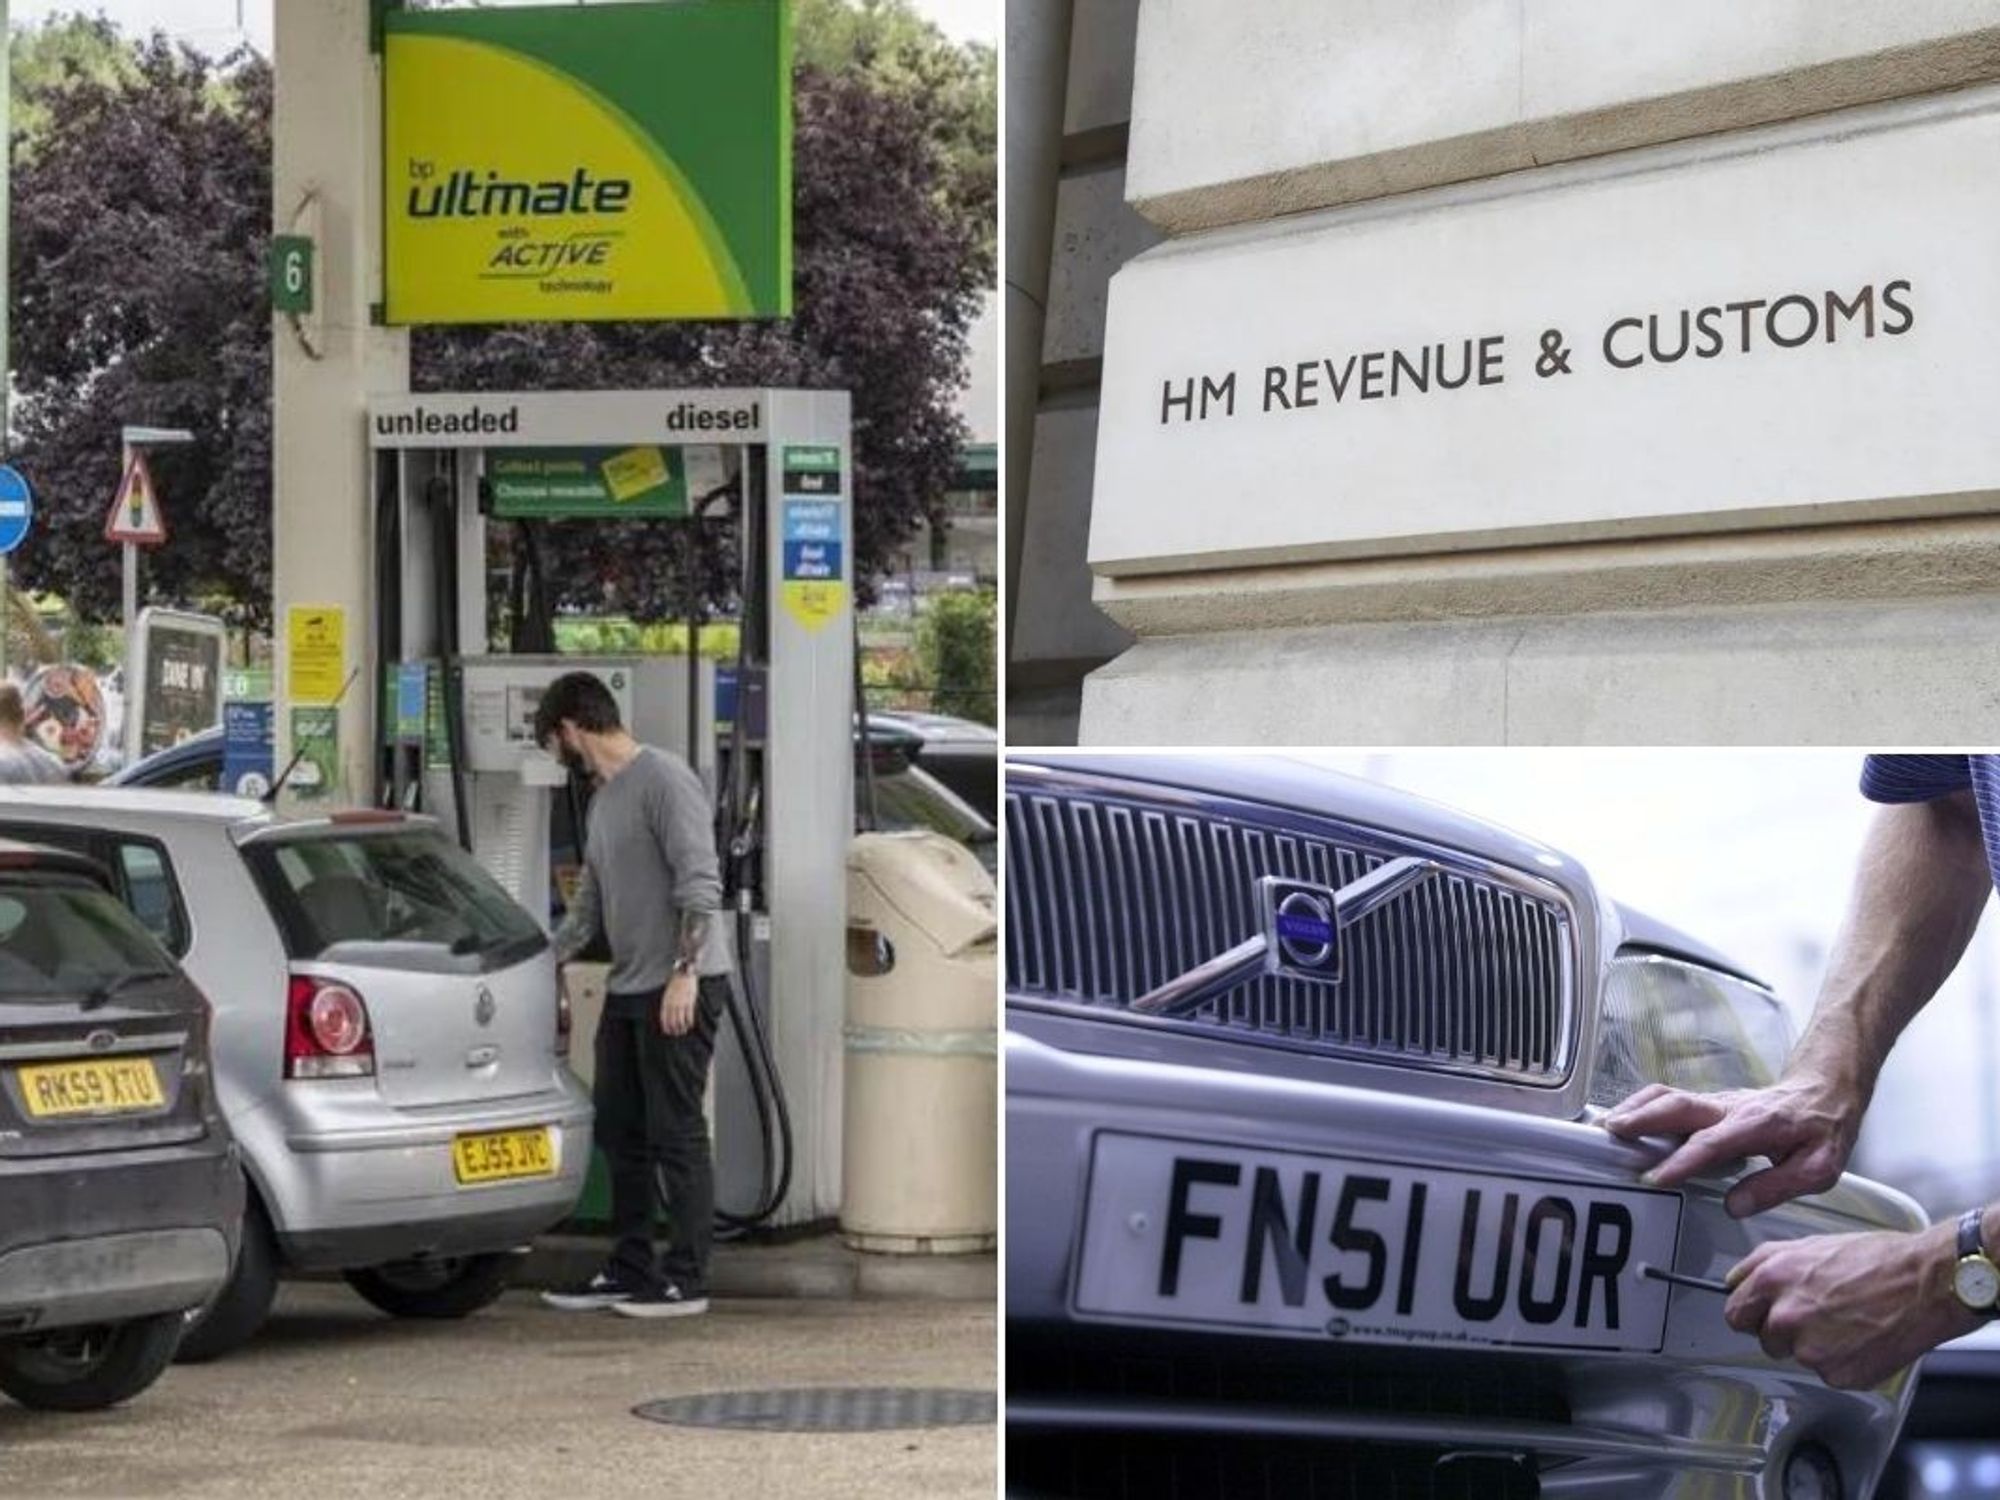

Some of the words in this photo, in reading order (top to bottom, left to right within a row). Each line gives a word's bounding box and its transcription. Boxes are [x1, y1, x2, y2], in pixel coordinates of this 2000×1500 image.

[408, 168, 631, 218] ultimate
[286, 251, 302, 293] 6
[489, 241, 610, 268] ACTIVE
[1161, 372, 1236, 424] HM
[1263, 336, 1505, 412] REVENUE
[1535, 329, 1573, 378] &
[1602, 279, 1915, 369] CUSTOMS
[376, 406, 519, 434] unleaded
[666, 403, 760, 431] diesel
[611, 672, 625, 690] 6
[1158, 1157, 1428, 1316] FN51
[1453, 1190, 1633, 1330] UOR
